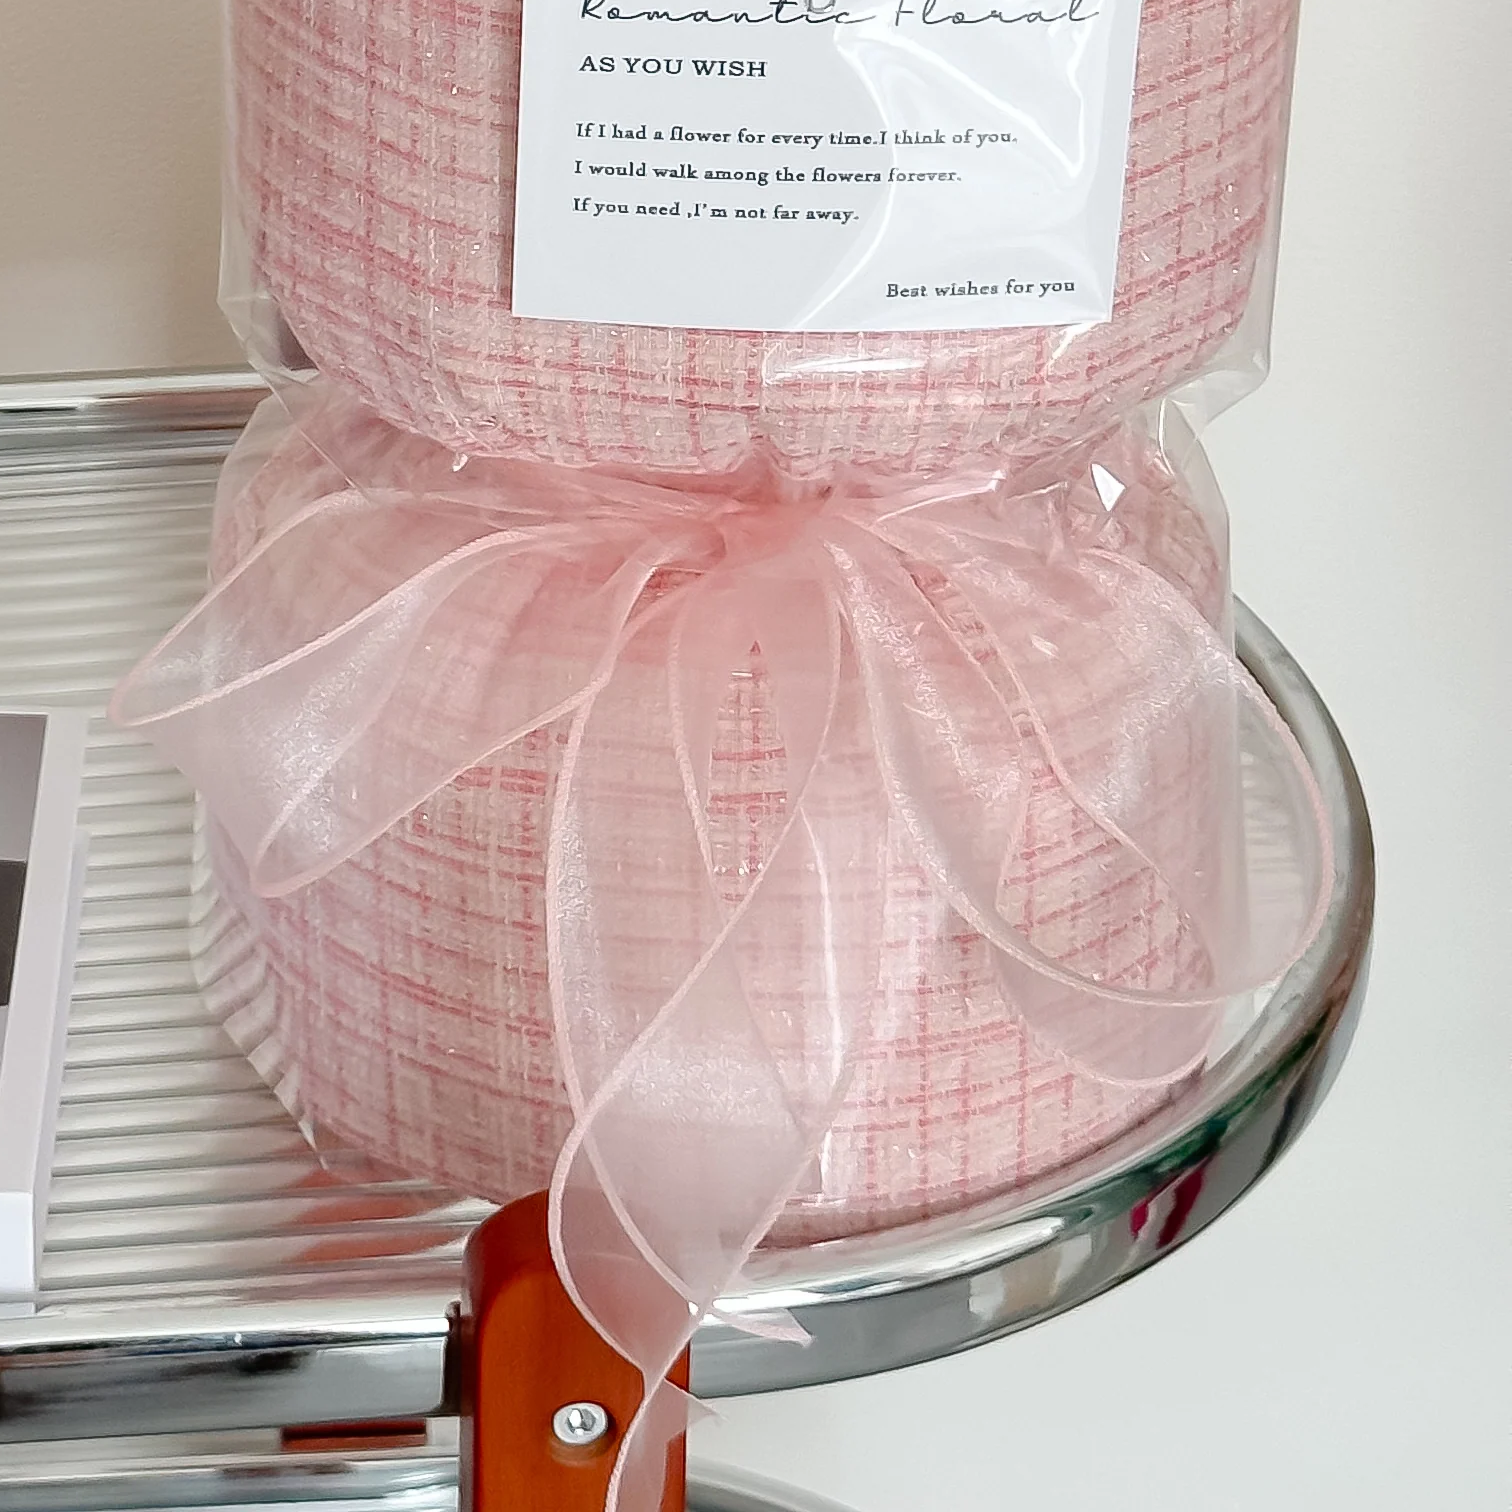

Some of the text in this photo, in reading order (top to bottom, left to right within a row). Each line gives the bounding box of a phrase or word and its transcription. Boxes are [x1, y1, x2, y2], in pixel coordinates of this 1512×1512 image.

[579, 55, 768, 77] AS YOU WISH
[576, 123, 594, 138] If
[597, 124, 606, 138] I
[611, 123, 647, 140] had
[653, 130, 664, 140] a
[670, 126, 731, 143] flower
[737, 128, 765, 144] for
[771, 133, 823, 150] every
[894, 129, 946, 145] think
[952, 129, 974, 144] of
[975, 132, 1018, 148] you.
[574, 160, 962, 186] I would walk among the flowers forever.
[573, 198, 591, 212] If
[593, 202, 629, 216] you
[635, 201, 681, 216] need
[734, 207, 767, 220] not
[772, 205, 800, 220] far
[805, 209, 859, 225] away.
[886, 279, 1076, 298] Best wishes for you
